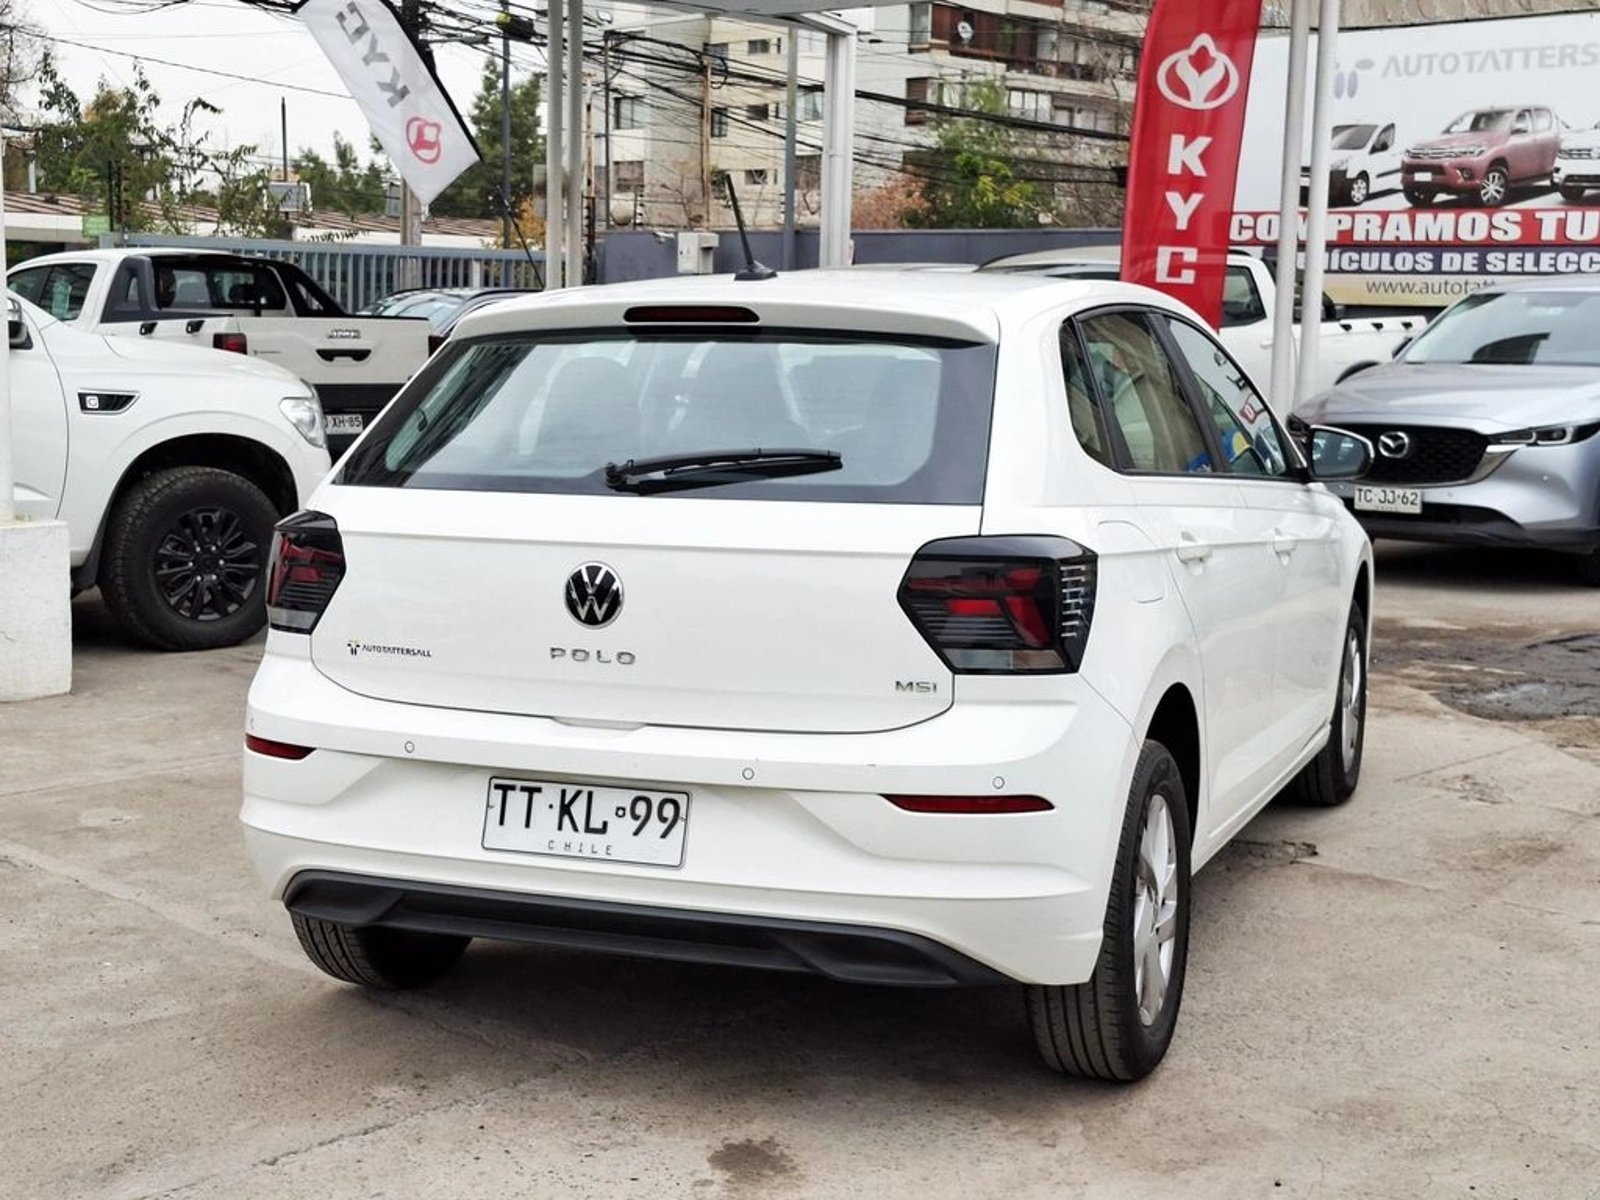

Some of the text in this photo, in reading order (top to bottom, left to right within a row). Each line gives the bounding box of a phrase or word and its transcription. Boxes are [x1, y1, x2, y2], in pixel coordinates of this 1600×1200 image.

[1156, 133, 1213, 285] KYC
[1441, 252, 1479, 273] DE
[1486, 251, 1600, 273] SELECC
[550, 646, 636, 666] POLO
[547, 839, 614, 857] CHILE
